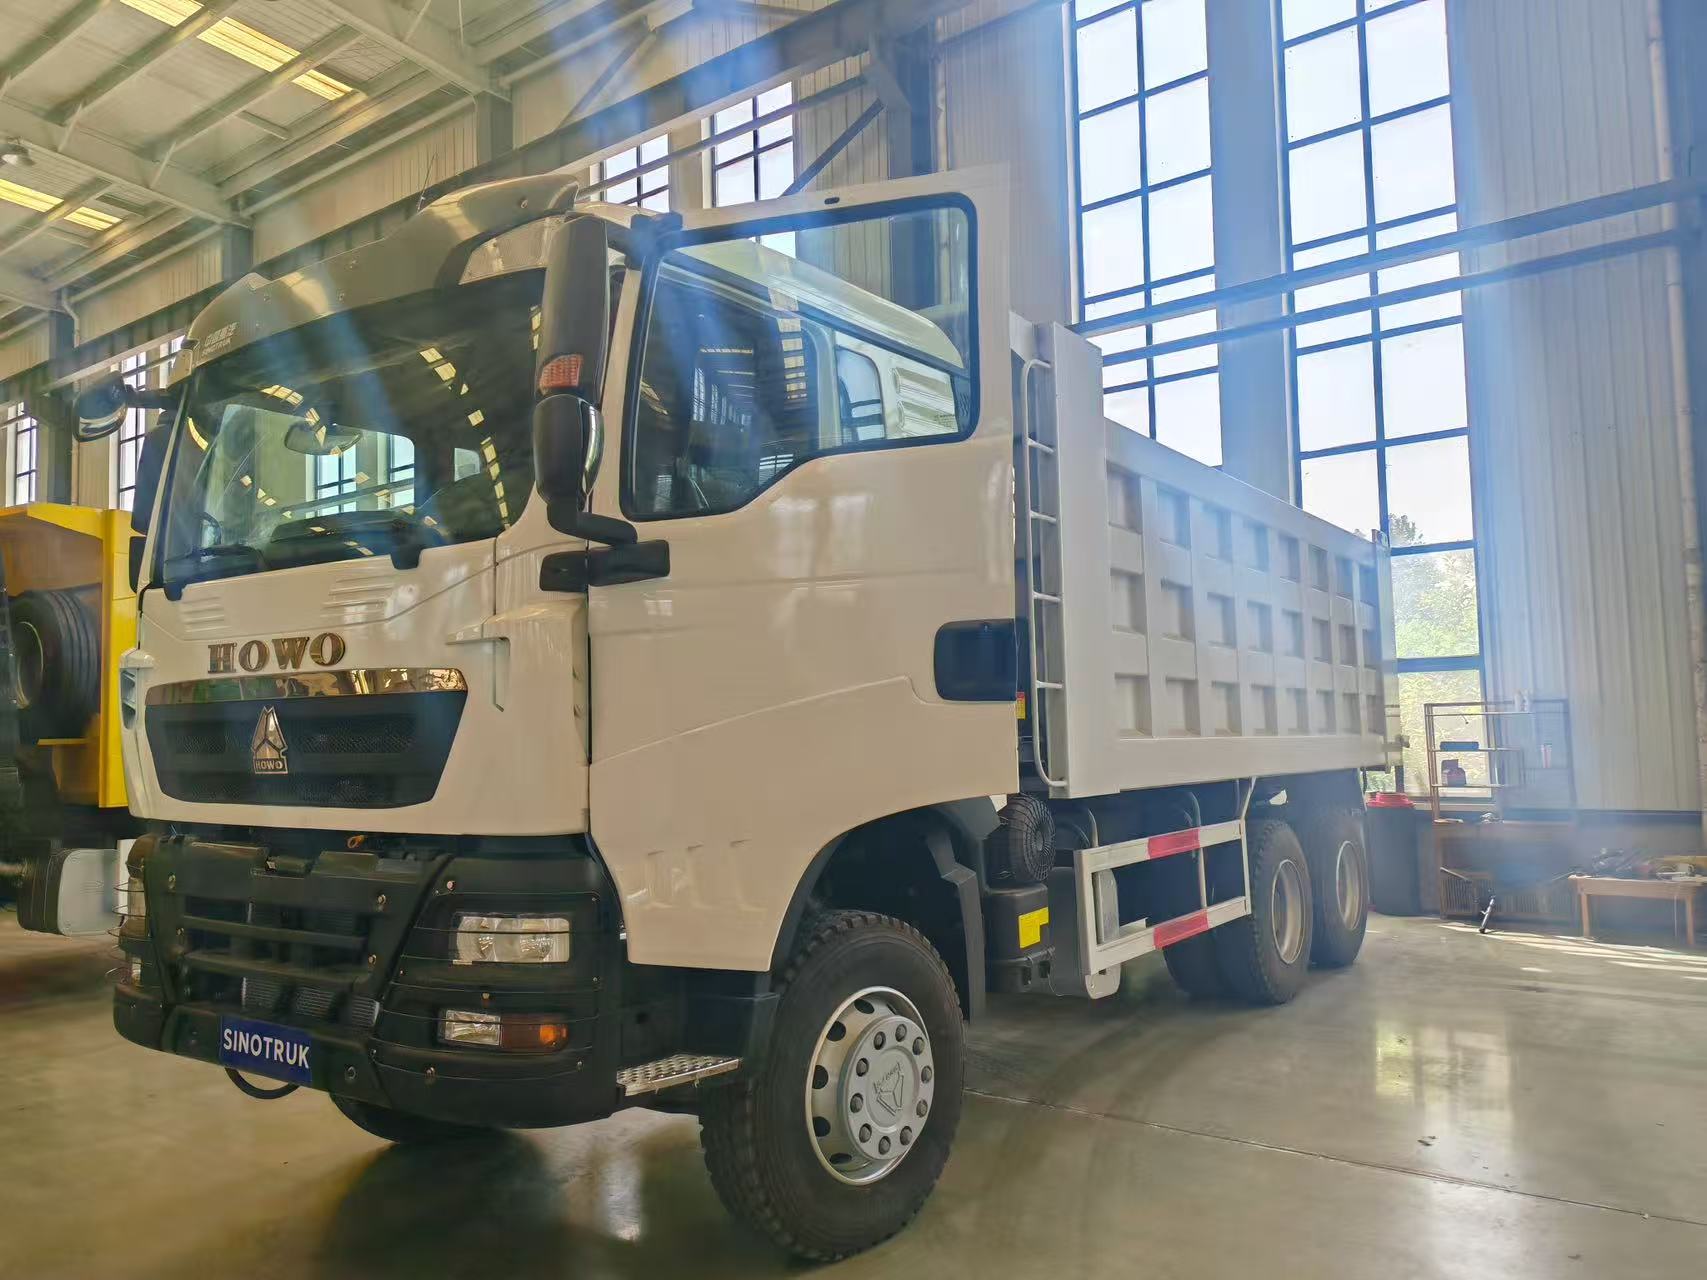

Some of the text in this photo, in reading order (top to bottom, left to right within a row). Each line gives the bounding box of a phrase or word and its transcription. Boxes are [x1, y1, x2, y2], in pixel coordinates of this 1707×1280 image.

[208, 632, 345, 674] HOWO
[255, 760, 283, 770] HOWO
[223, 1028, 310, 1069] SINOTRUK
